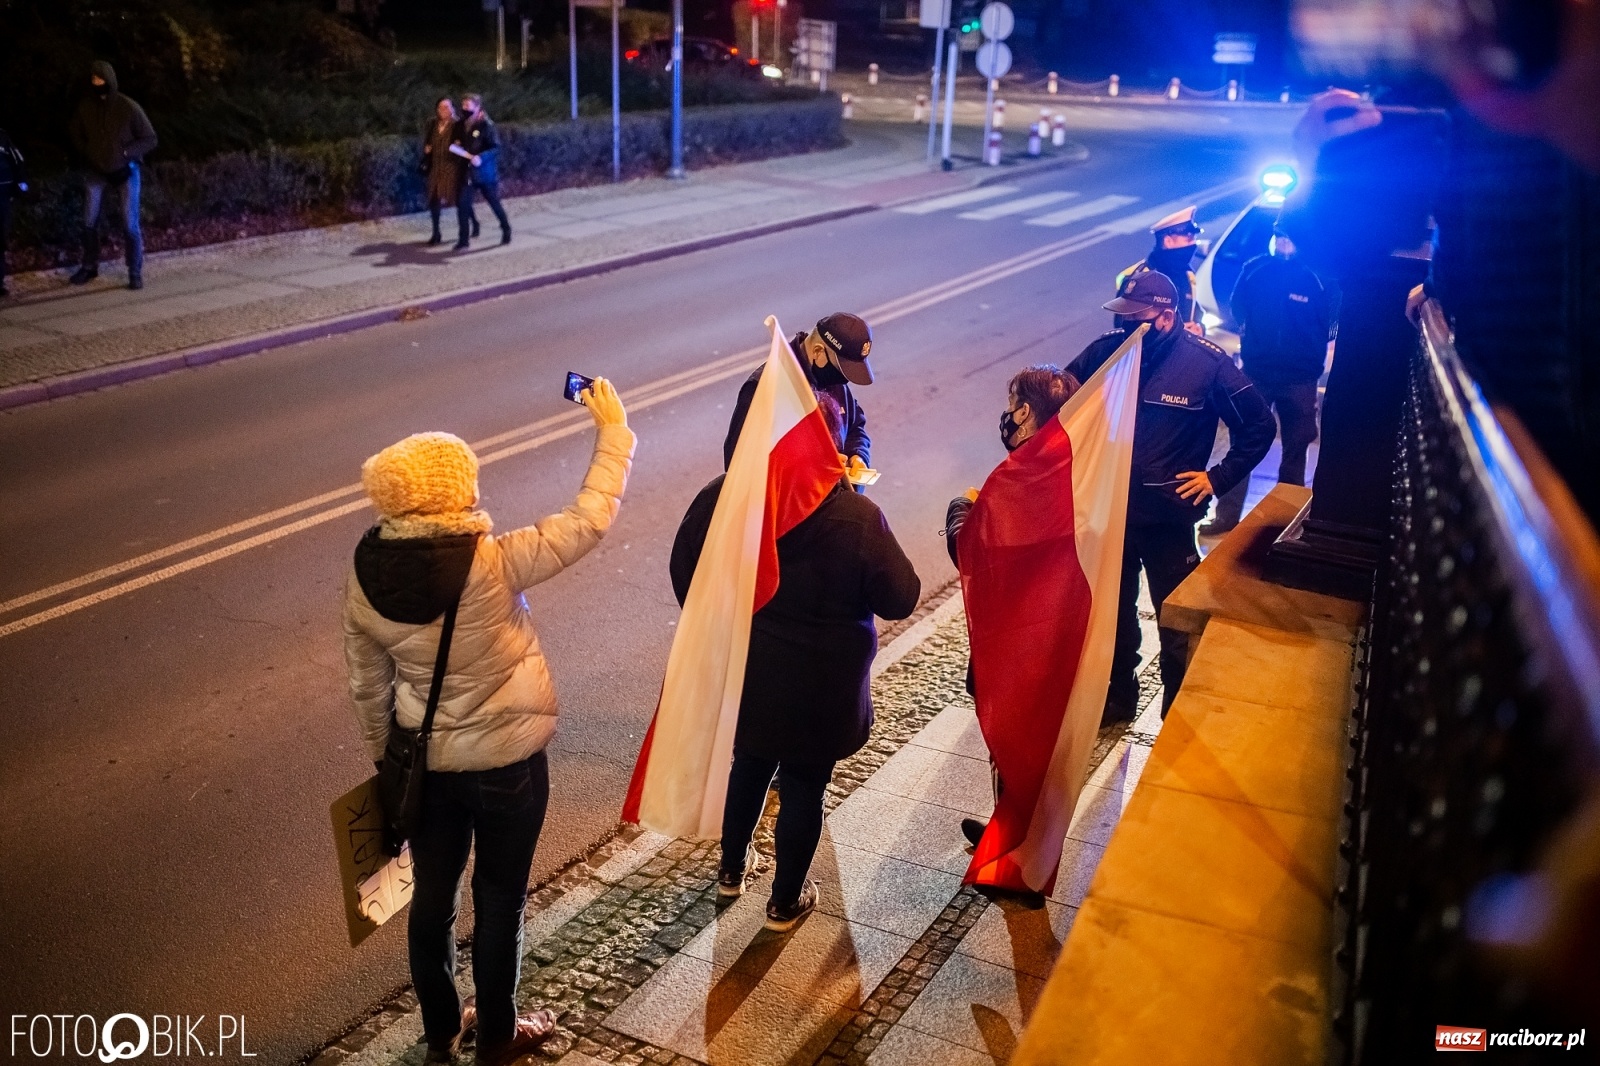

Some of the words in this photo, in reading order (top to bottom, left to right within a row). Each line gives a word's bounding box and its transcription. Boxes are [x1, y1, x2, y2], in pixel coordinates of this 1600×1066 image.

[1153, 295, 1172, 304] POLICJA
[824, 331, 843, 351] POLICJA
[1161, 393, 1189, 406] POLICJA
